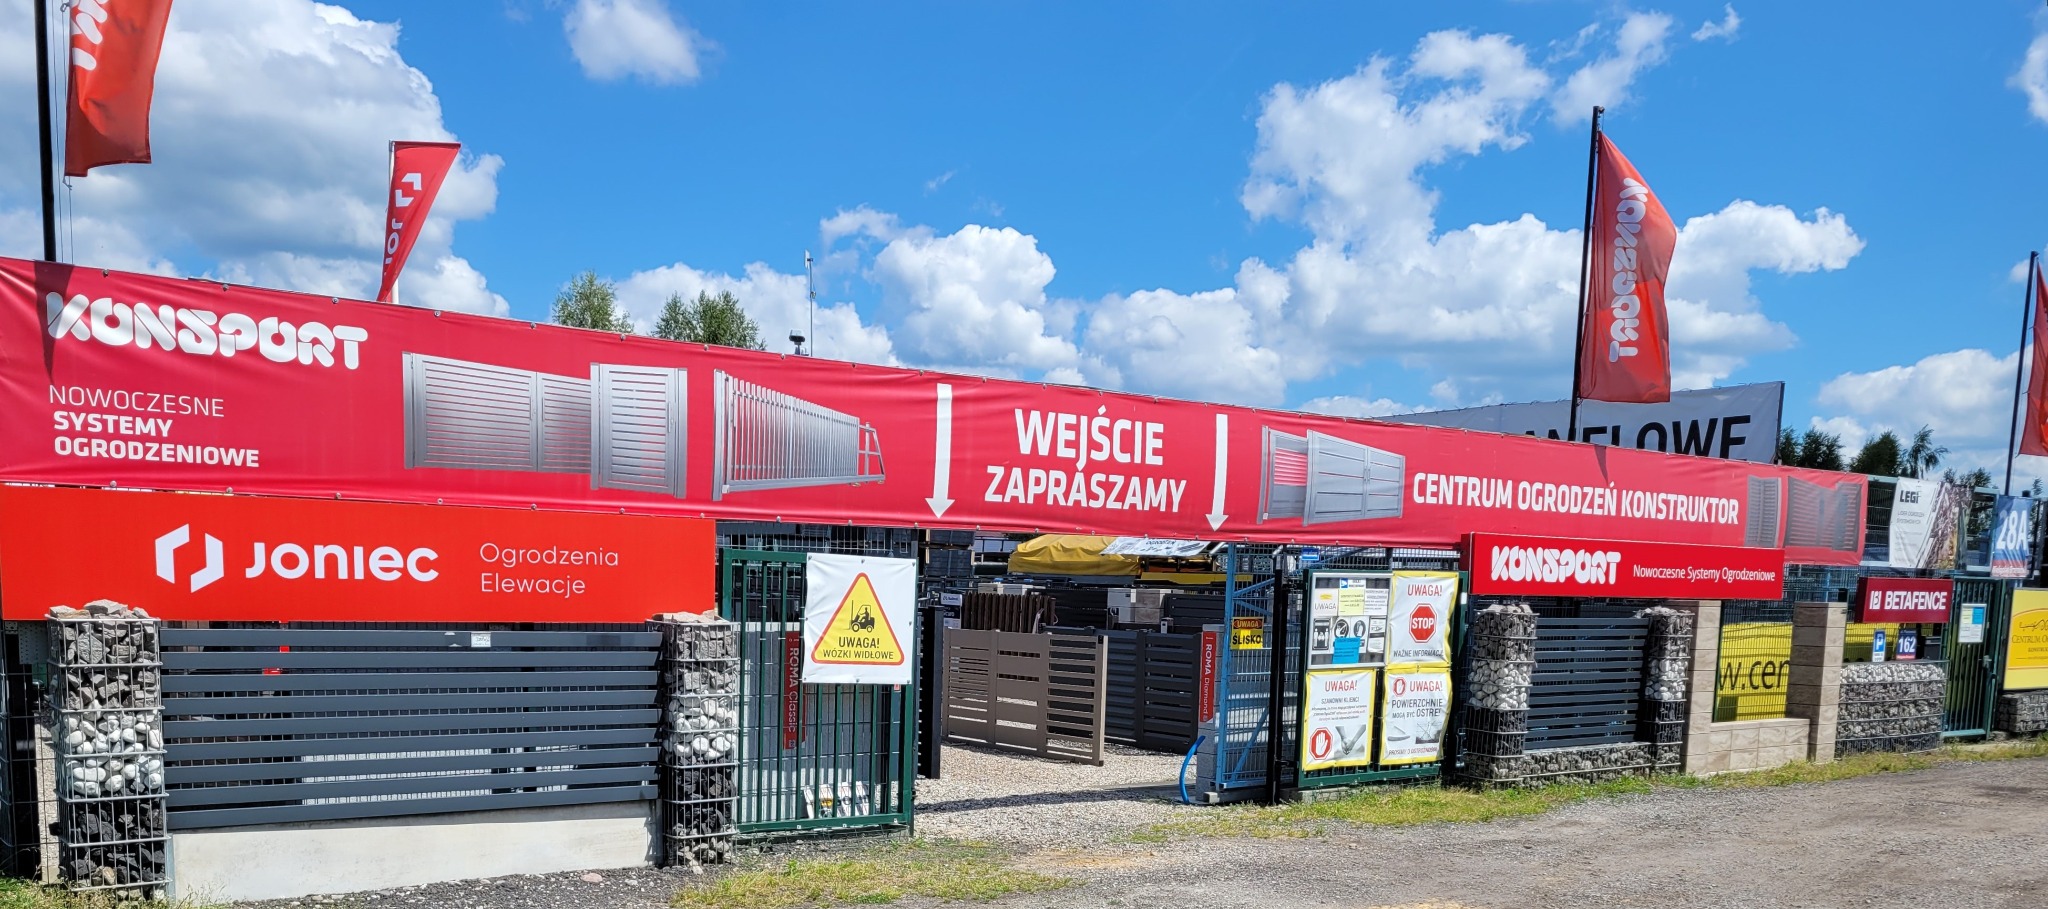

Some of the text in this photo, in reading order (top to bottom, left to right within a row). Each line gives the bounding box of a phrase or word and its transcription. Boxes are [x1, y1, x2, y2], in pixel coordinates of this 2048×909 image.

[46, 292, 368, 370] KONSPORT
[50, 385, 224, 417] NOWOCZESNE
[54, 411, 173, 437] SYSTEMY
[1015, 404, 1163, 471] WEJŚCIE
[54, 436, 259, 468] OGRODZENIOWE
[985, 465, 1187, 513] ZAPRASZAMY
[1413, 472, 1739, 525] CENTRUM OGRODZEŃ KONSTRUKTOR
[1996, 509, 2027, 550] 28A
[480, 542, 620, 569] Ogrodzenia
[1491, 545, 1776, 585] KONSPORT Nowoczesne Systemy Ogrodzeniowe
[481, 573, 586, 598] Elewacje
[1408, 584, 1443, 597] UWAGA!
[1884, 591, 1947, 610] BETAFENCE
[1238, 620, 1259, 628] UWAGA
[1412, 617, 1435, 629] STOP
[839, 636, 880, 649] UWAGA!
[1232, 633, 1261, 645] ŚLISKO
[1898, 636, 1916, 653] 162
[823, 648, 894, 659] WÓZKI WIDŁOWE
[1204, 644, 1213, 675] ROMA
[1393, 649, 1412, 657] WAŻNE
[789, 647, 799, 688] ROMA
[1325, 680, 1358, 692] UWAGA!
[1410, 680, 1443, 692] UWAGA!
[788, 691, 798, 732] Classic
[1392, 699, 1443, 708] POWIERZCHNIE
